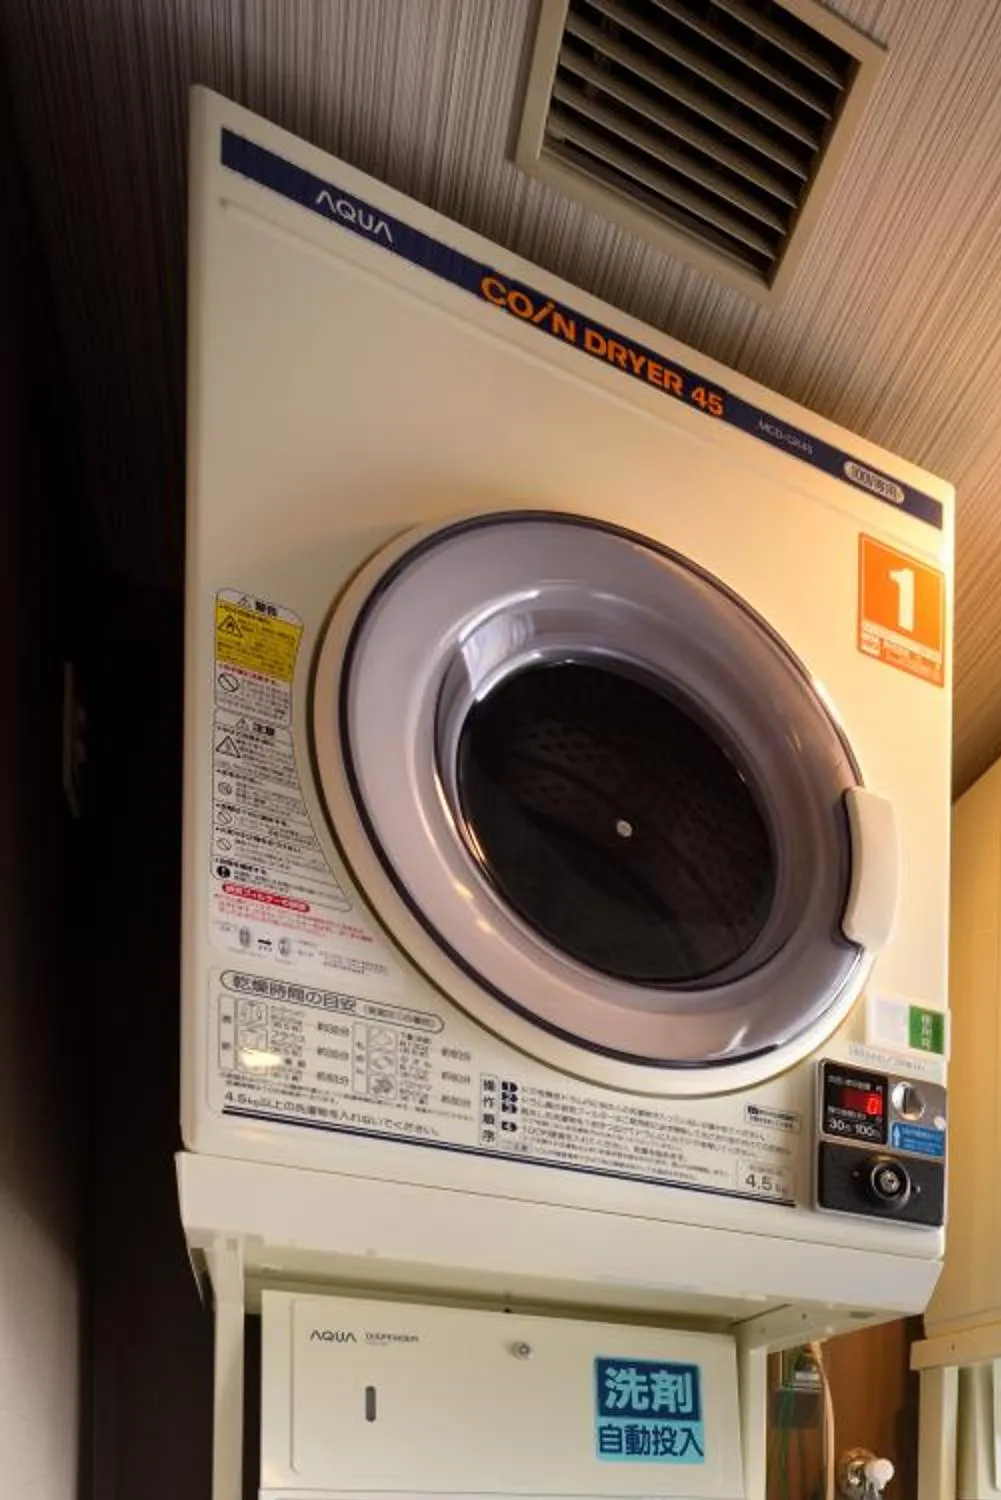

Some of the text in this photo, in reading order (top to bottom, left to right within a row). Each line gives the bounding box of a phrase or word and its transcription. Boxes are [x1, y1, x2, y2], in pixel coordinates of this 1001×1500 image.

[315, 190, 394, 244] AQUA
[584, 327, 684, 396] DRYER
[691, 384, 725, 418] 45
[887, 567, 915, 633] 1
[309, 1328, 358, 1344] AQUA
[603, 1365, 694, 1415] 洗剤
[599, 1423, 704, 1458] 自動投入
